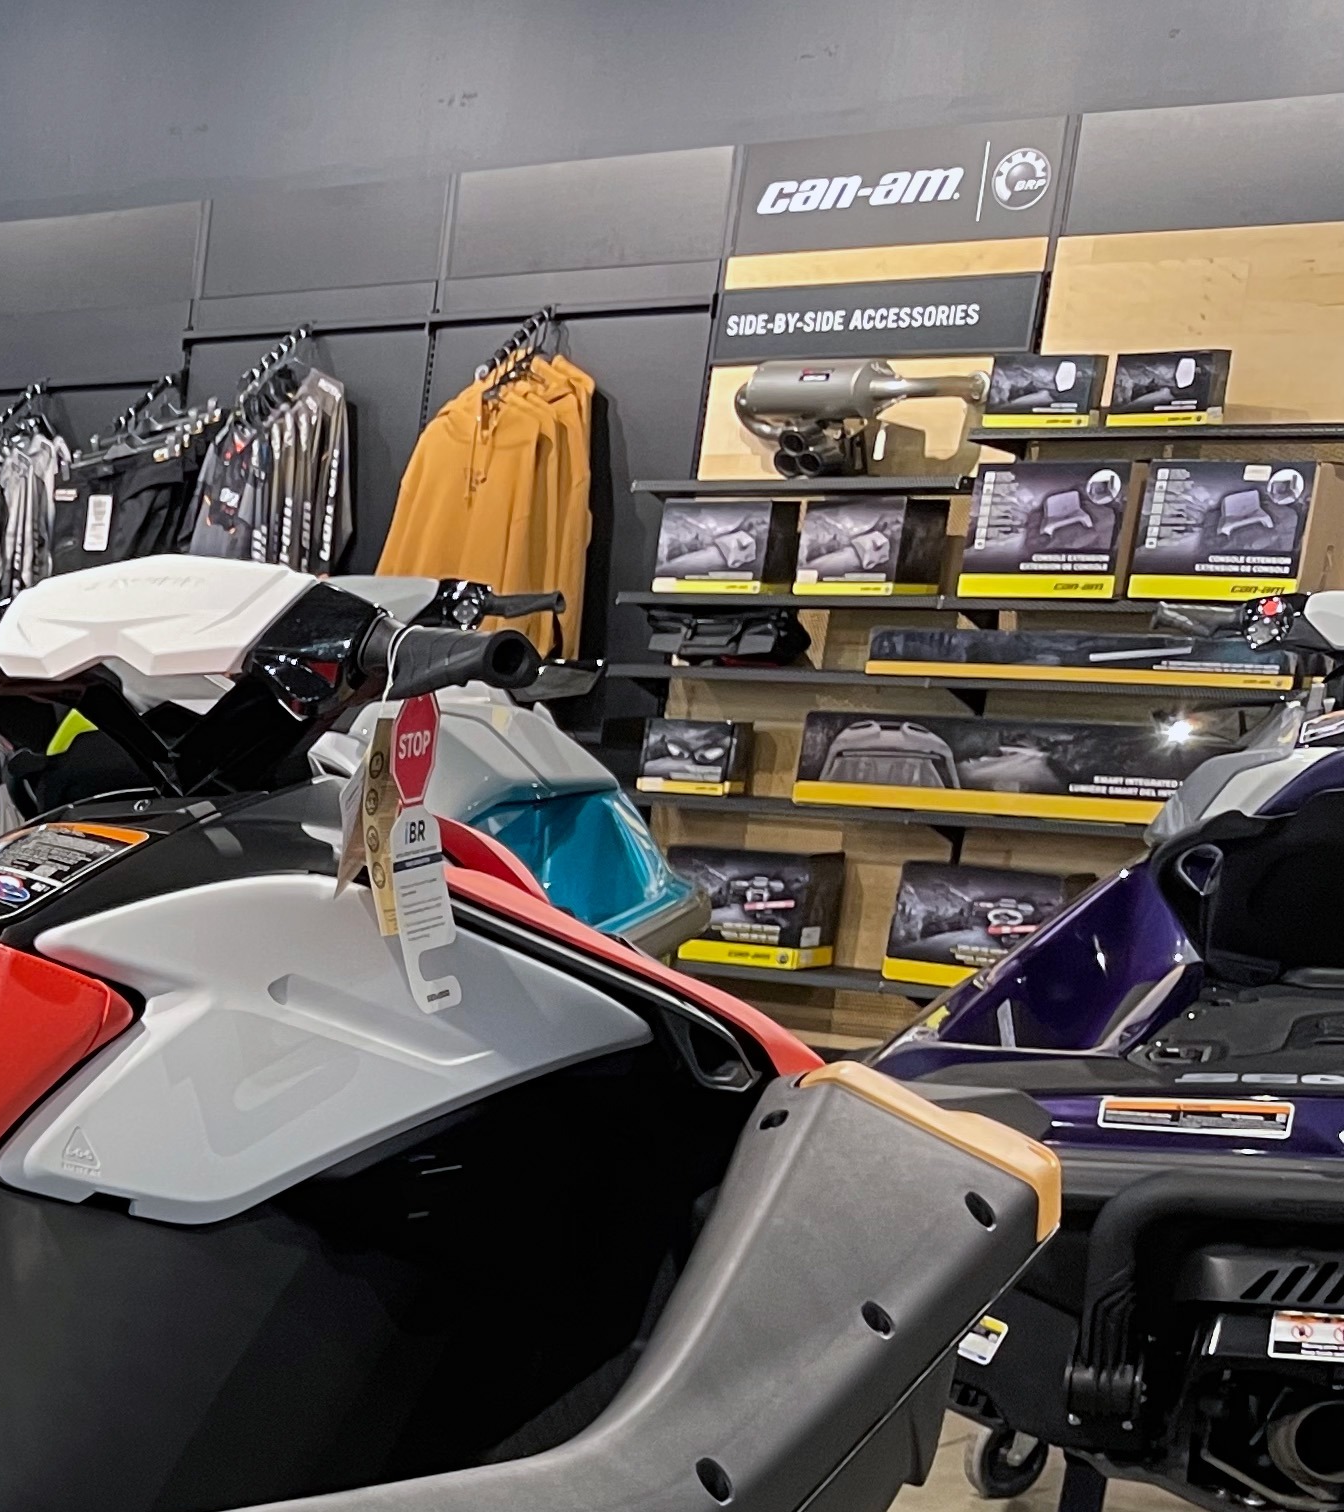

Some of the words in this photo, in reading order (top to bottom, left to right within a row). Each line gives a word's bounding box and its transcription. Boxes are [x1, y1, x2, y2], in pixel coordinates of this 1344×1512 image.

[756, 167, 964, 215] can-am
[726, 310, 846, 337] SIDE-BY-SIDE
[848, 303, 980, 332] ACCESSORIES
[398, 730, 431, 759] STOP
